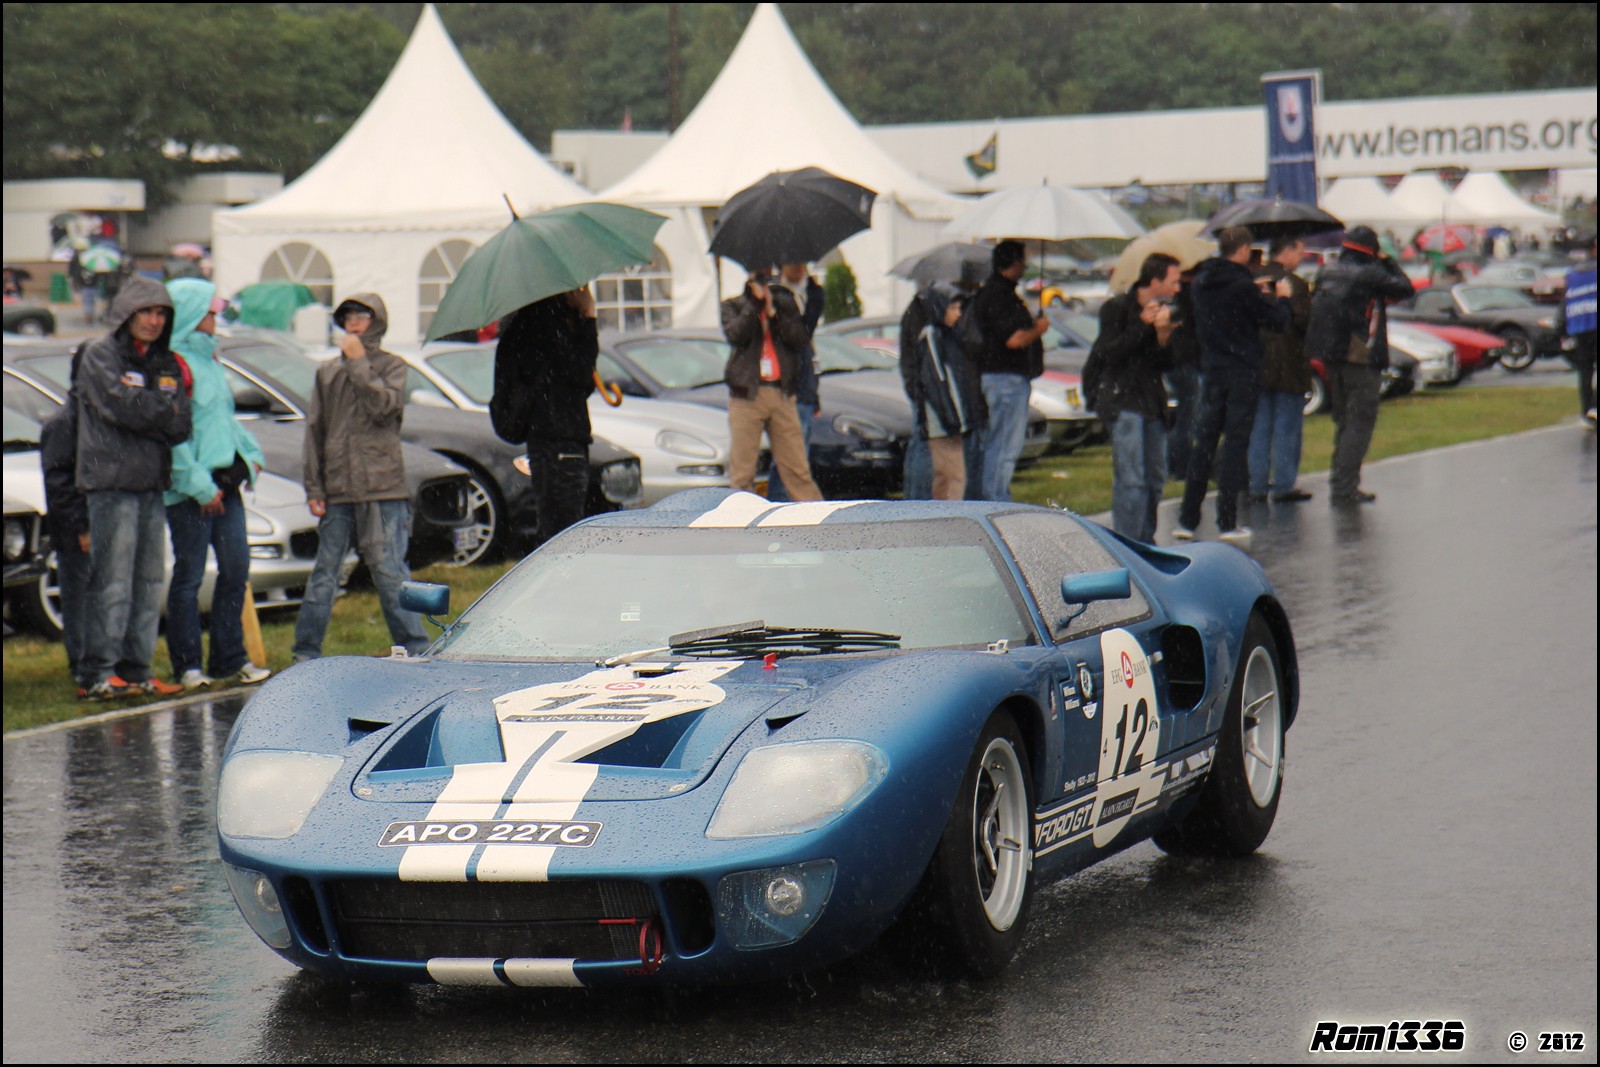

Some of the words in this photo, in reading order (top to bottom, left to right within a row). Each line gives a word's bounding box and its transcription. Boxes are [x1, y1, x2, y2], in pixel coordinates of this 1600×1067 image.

[1112, 697, 1148, 781] 12
[388, 824, 478, 843] APO
[486, 824, 590, 843] 227C
[1036, 810, 1076, 848] FORD
[1071, 803, 1094, 832] GT
